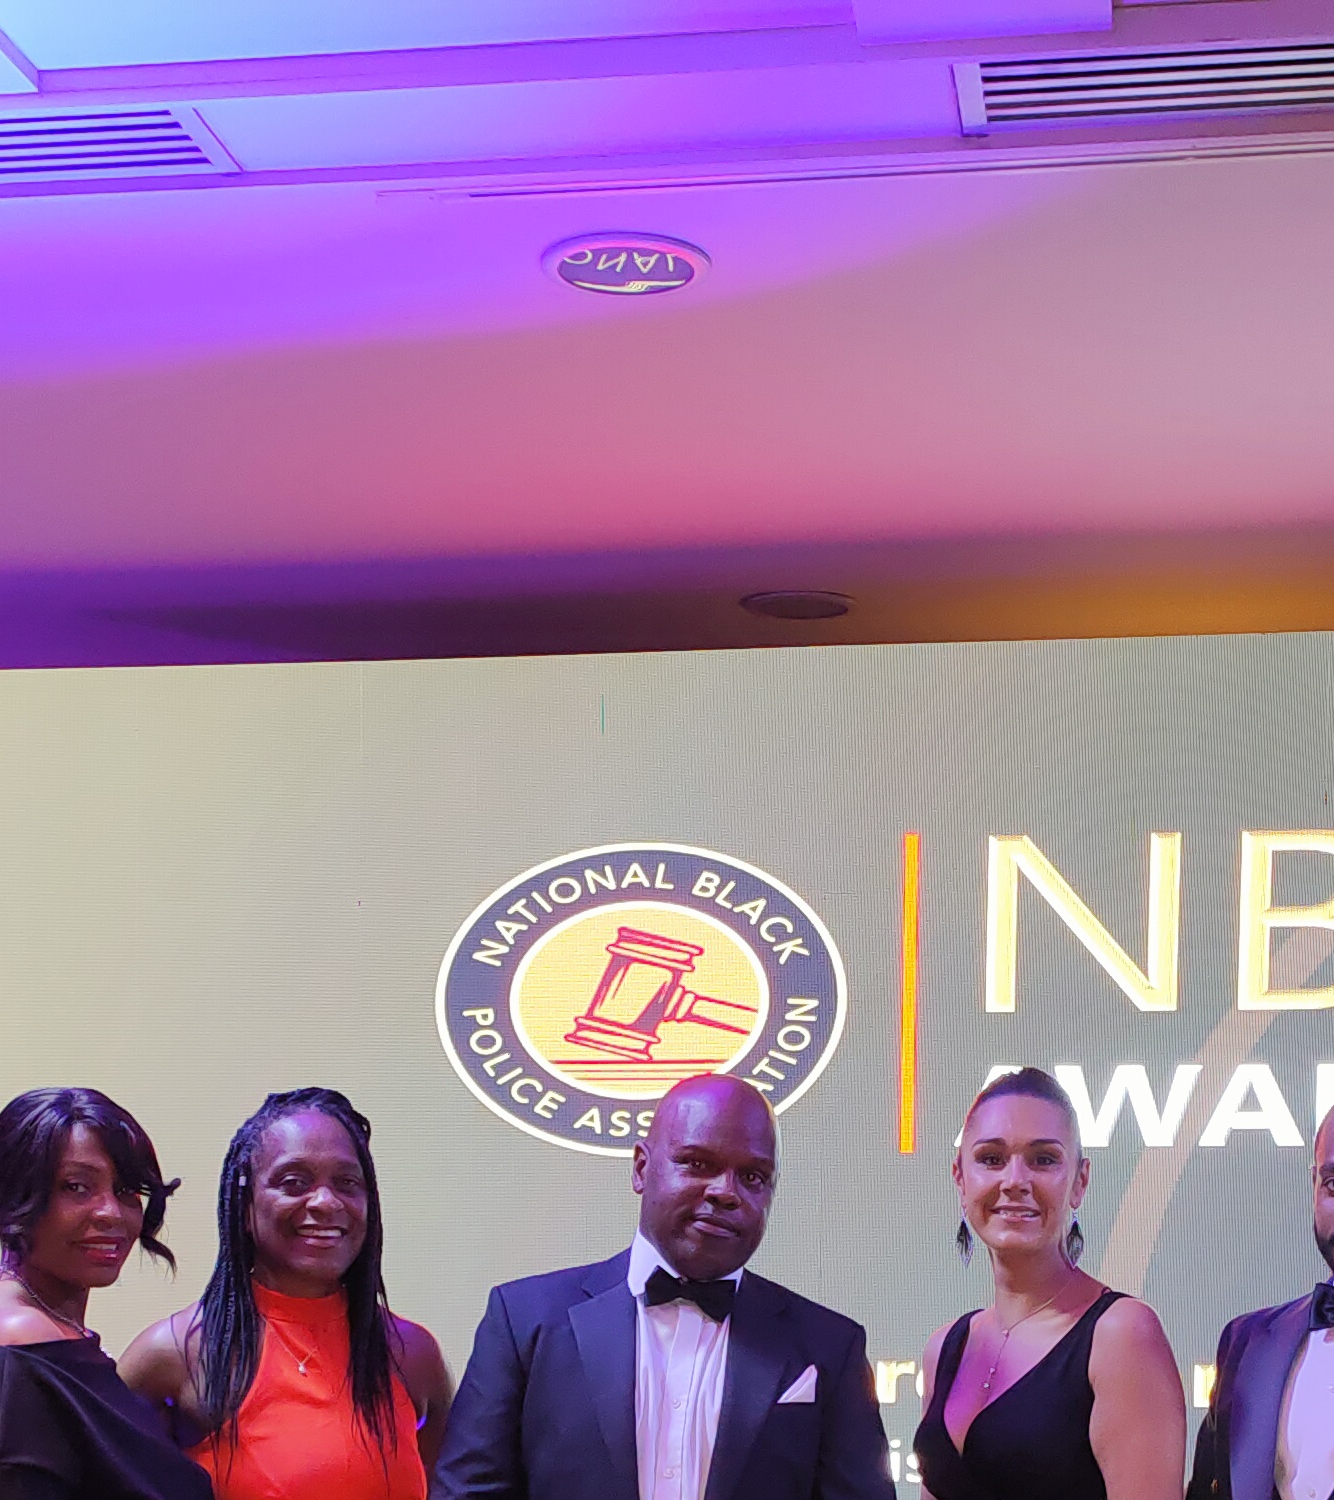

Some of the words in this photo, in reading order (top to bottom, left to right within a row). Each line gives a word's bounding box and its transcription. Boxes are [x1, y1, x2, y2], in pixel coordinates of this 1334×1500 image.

[471, 862, 675, 968] NATIONAL
[691, 868, 811, 966] BLACK
[462, 1006, 567, 1120] POLICE
[573, 995, 820, 1140] ASSTION
